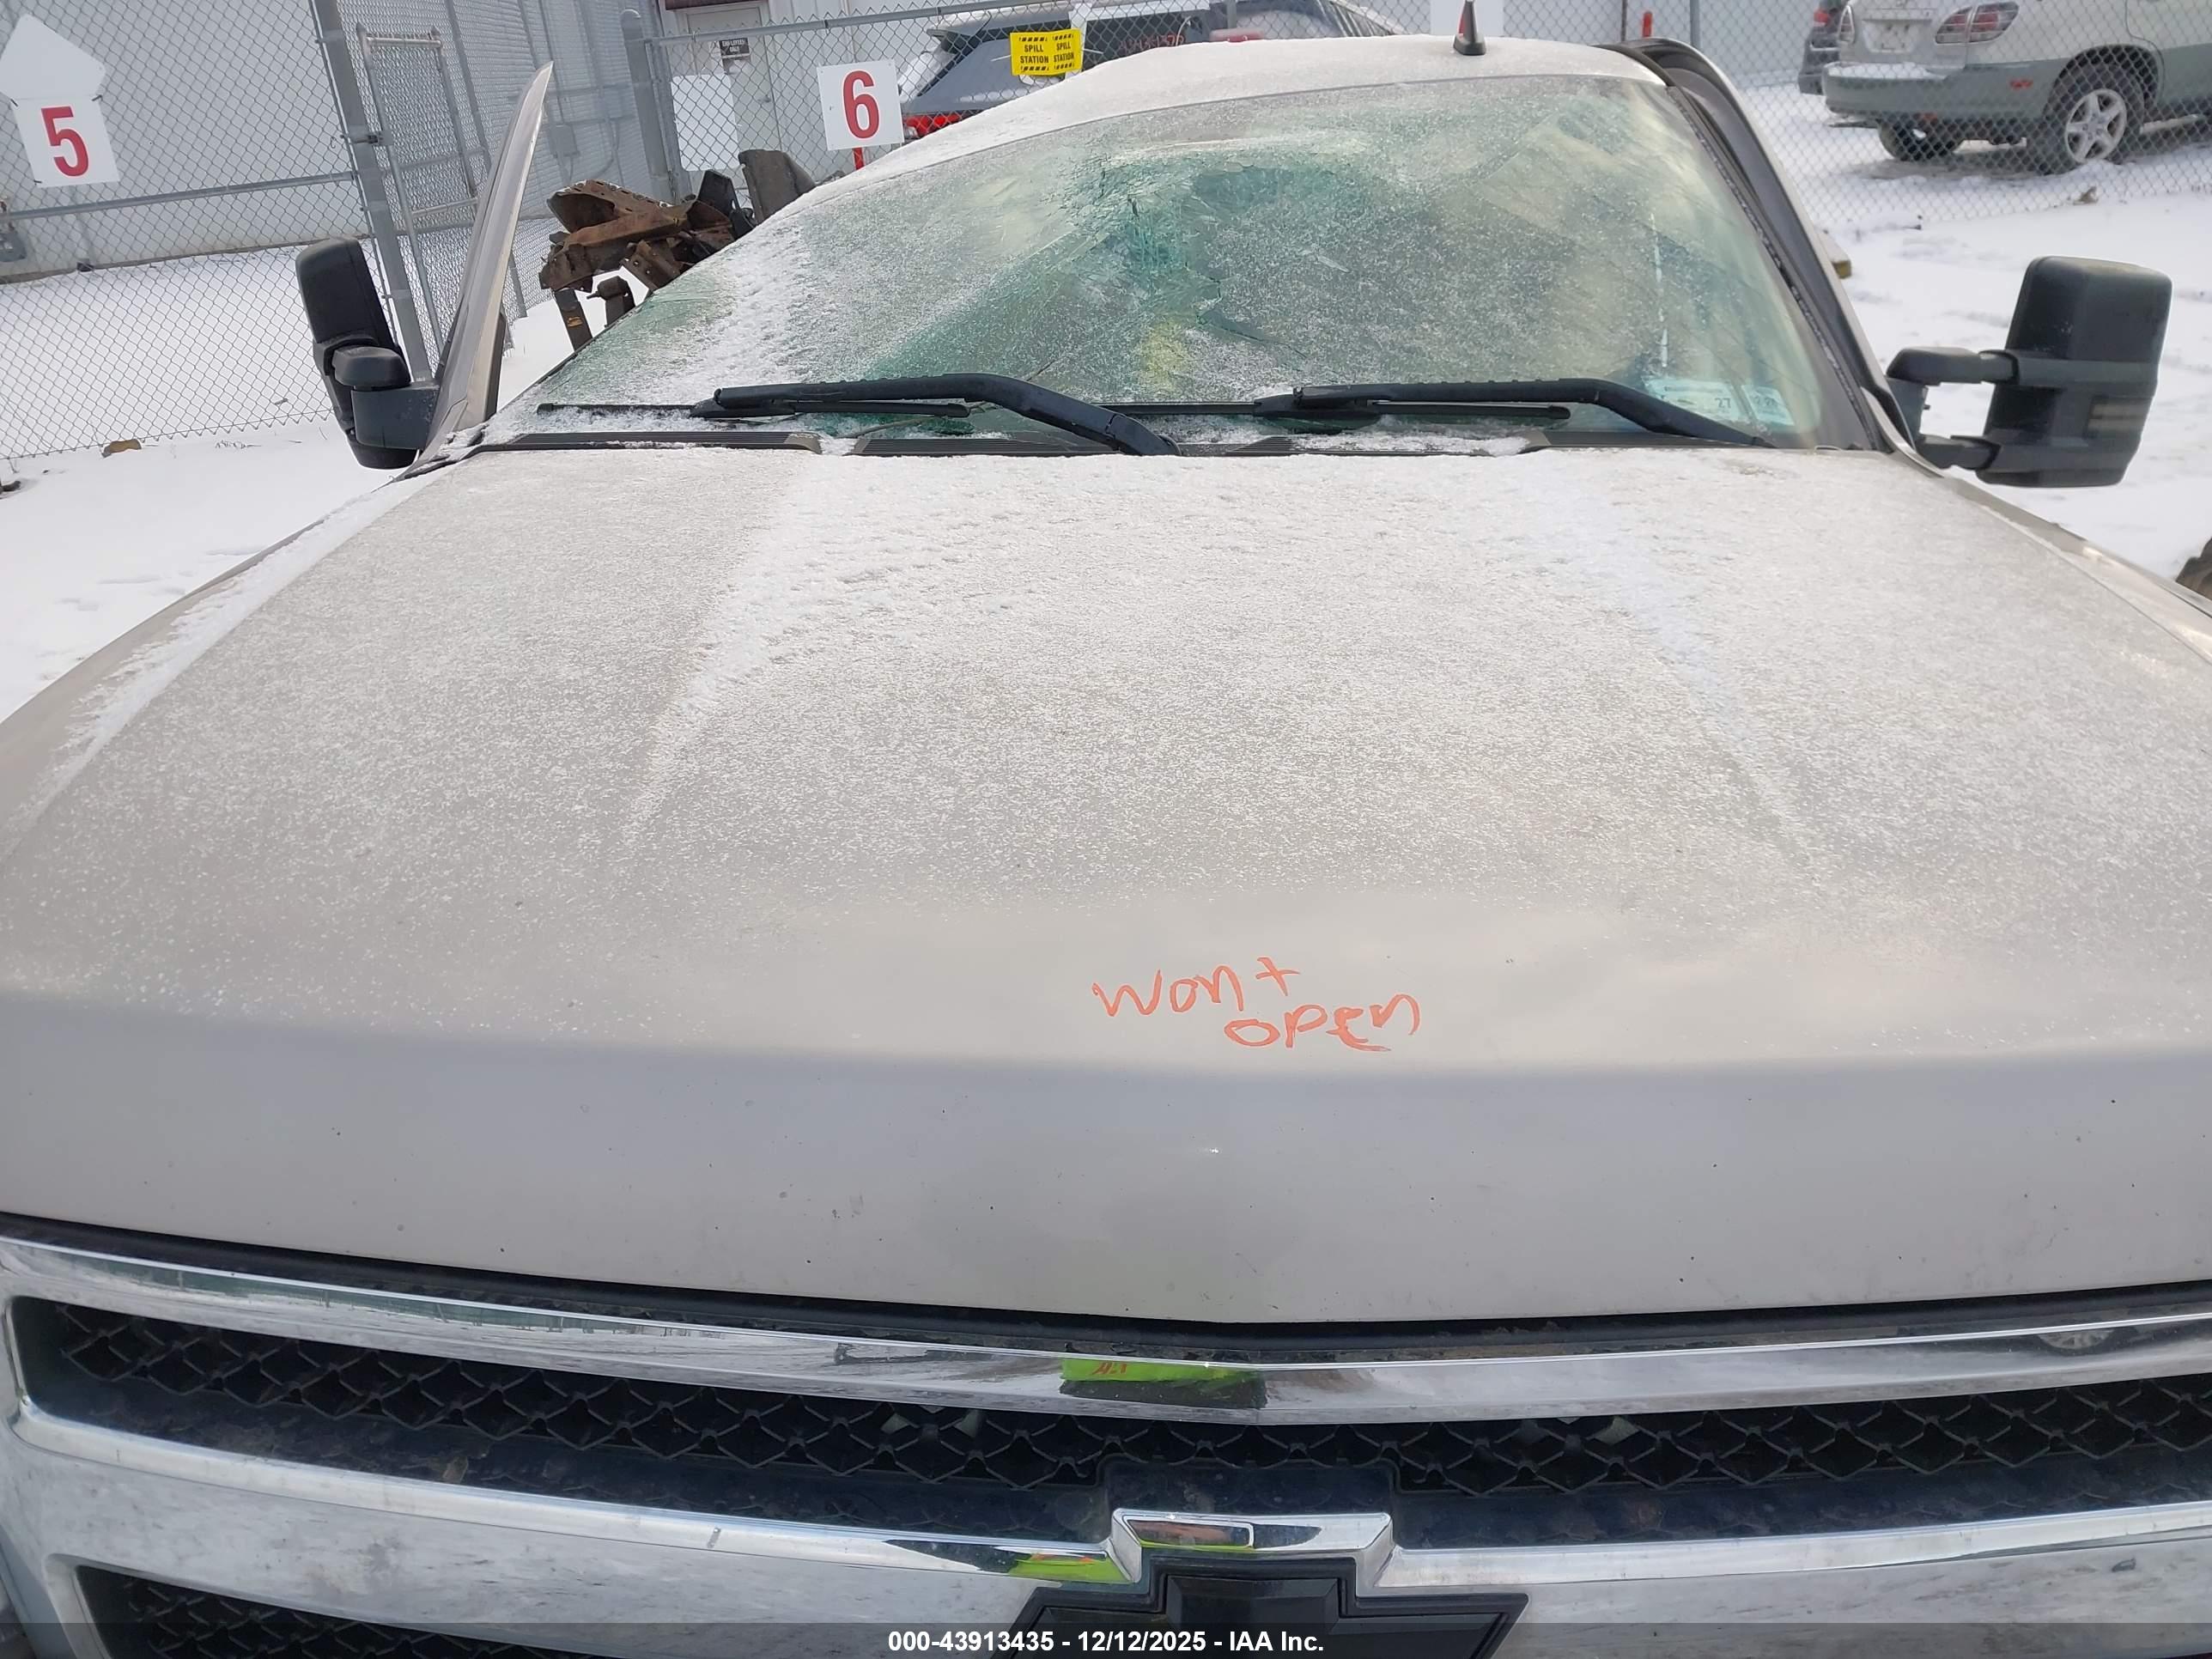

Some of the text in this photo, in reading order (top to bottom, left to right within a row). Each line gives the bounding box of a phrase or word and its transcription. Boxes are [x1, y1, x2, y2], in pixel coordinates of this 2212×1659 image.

[1024, 44, 1044, 52] SPILL
[1056, 41, 1072, 51] SPILL
[1019, 55, 1049, 64] STATION
[1053, 52, 1075, 63] STATION
[842, 70, 880, 139] 6
[40, 105, 89, 177] 5
